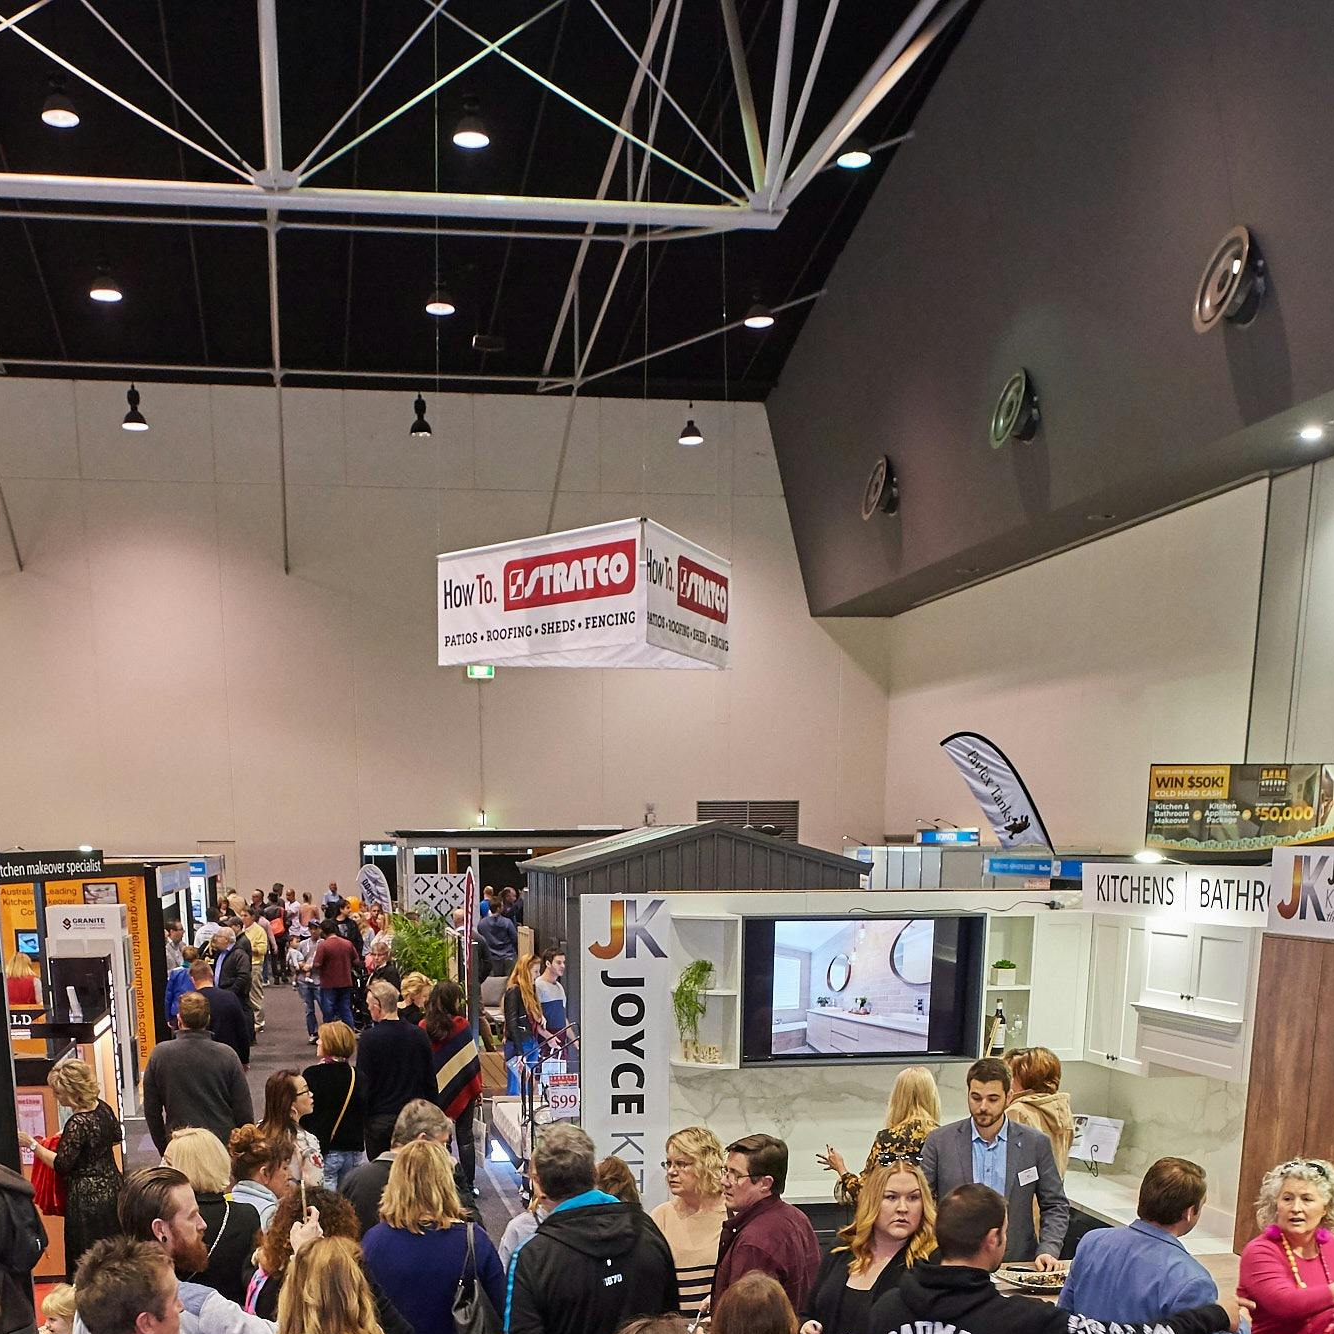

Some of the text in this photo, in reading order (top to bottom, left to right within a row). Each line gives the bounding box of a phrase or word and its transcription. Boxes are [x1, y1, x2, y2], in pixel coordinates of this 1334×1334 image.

[444, 579, 475, 610] How
[523, 551, 630, 598] STRATCO
[646, 547, 664, 587] How
[687, 571, 728, 614] STRATCO
[444, 610, 636, 647] PATIOS ROOFING SHEDS FENCING
[646, 610, 665, 629] PATIOS
[668, 619, 690, 638] ROOFING
[1155, 775, 1225, 789] WIN $50K!
[1177, 789, 1200, 797] HARD
[991, 783, 1014, 824] Tanks
[1155, 802, 1190, 811] Kitchen &
[1208, 801, 1237, 810] Kitchen
[1154, 809, 1190, 818] Bathroom
[1154, 816, 1190, 825] Makeover
[1204, 809, 1241, 818] Appliance
[1206, 816, 1238, 825] Package
[1255, 806, 1315, 824] $50,000
[27, 860, 65, 876] makeover
[66, 858, 102, 876] specialist
[1096, 873, 1271, 912] KITCHENS BATHR
[1277, 855, 1329, 922] JK
[588, 899, 668, 960] JK
[128, 877, 148, 1058] www.granitetransformations.com.au
[602, 971, 645, 1115] JOYCE
[551, 1094, 577, 1110] $99
